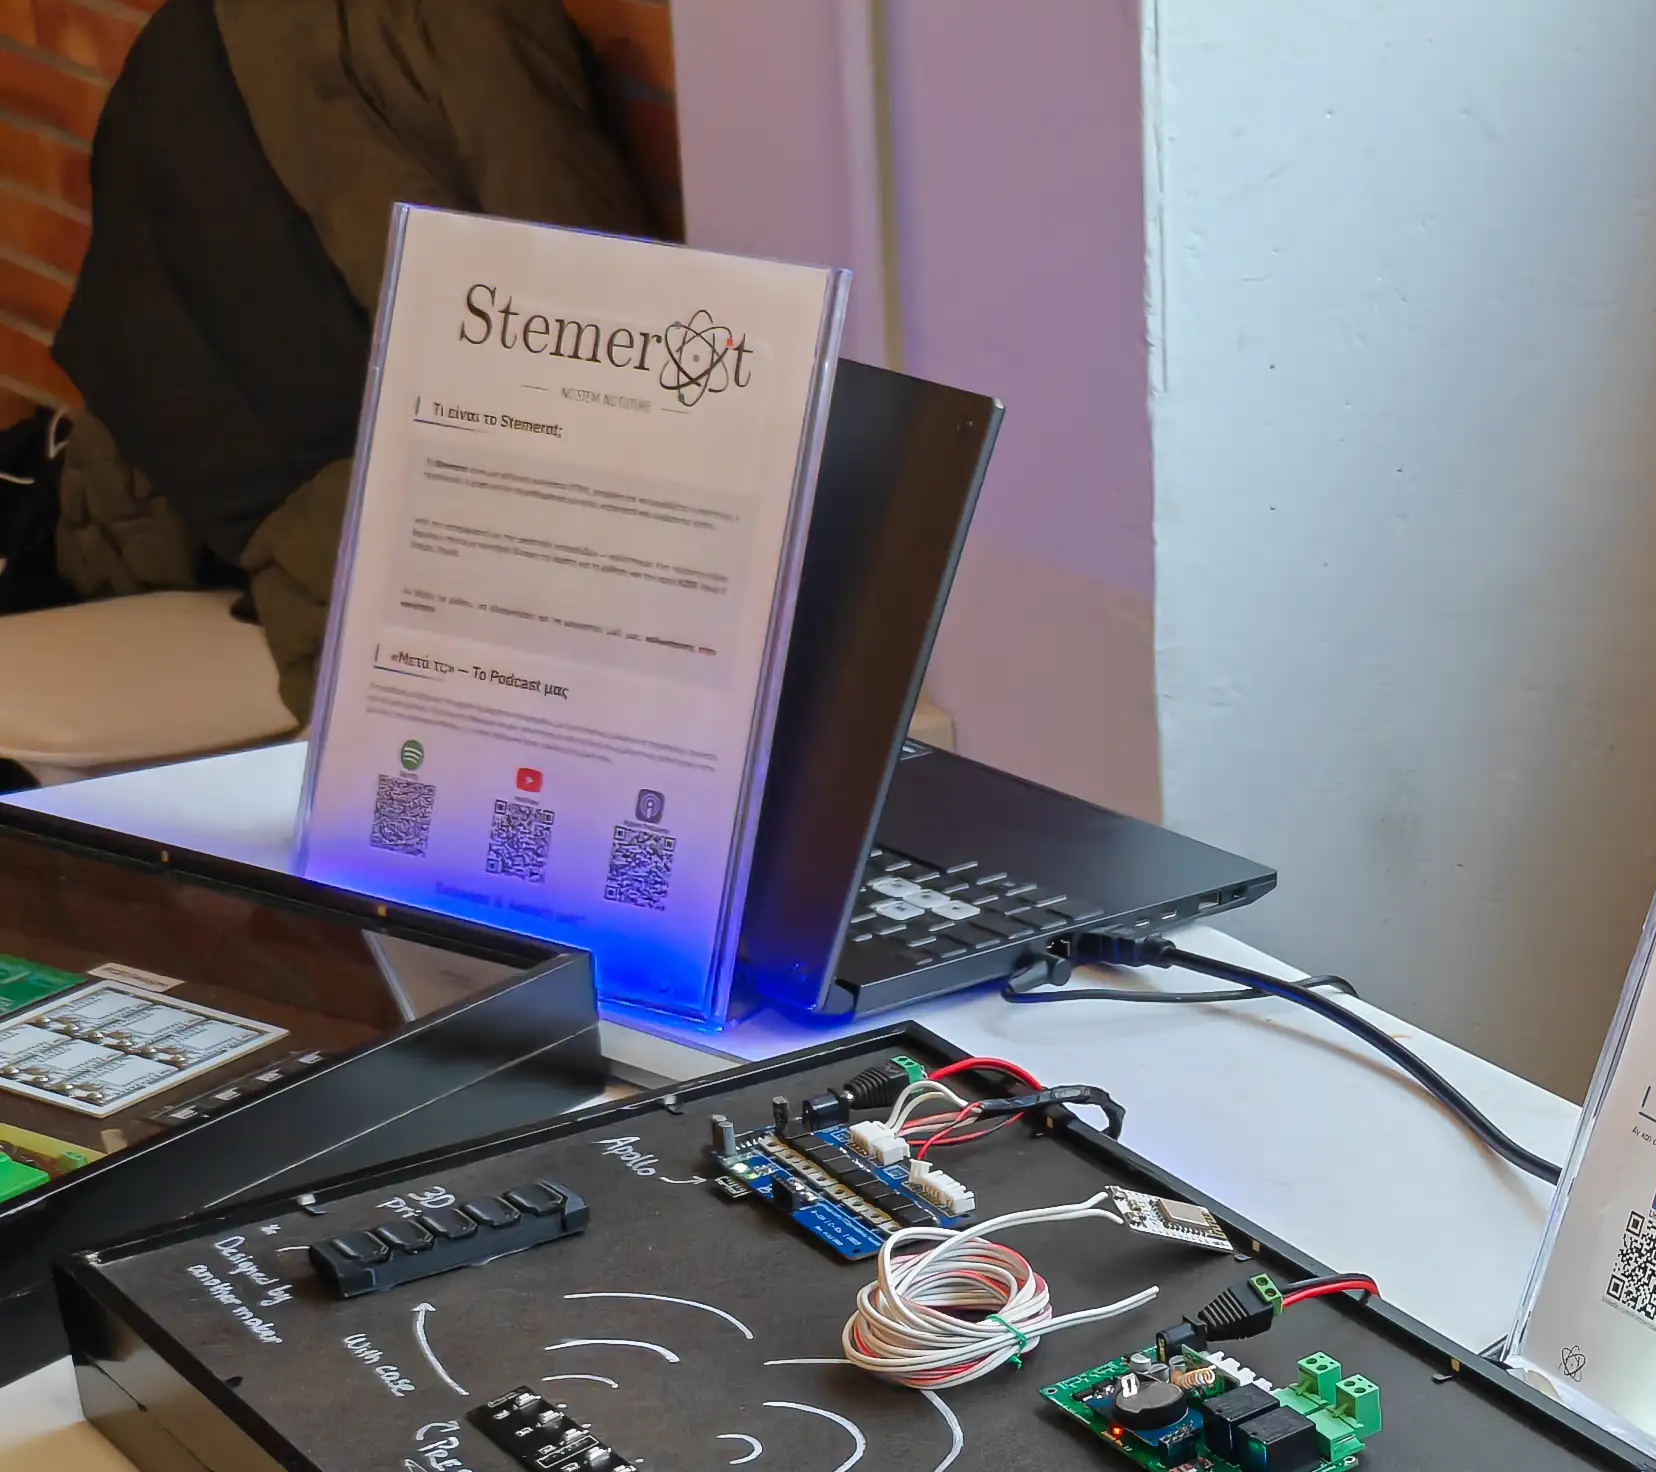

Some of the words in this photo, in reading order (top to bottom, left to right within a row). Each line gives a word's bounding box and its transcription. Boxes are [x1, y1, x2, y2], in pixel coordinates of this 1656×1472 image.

[490, 669, 541, 694] Podcast
[601, 1136, 658, 1178] Apollo
[408, 1186, 455, 1209] 3D
[214, 1235, 280, 1285] Designed
[260, 1284, 293, 1307] by
[187, 1264, 243, 1305] another
[232, 1304, 283, 1344] maker
[343, 1332, 384, 1365] With
[375, 1364, 416, 1397] case
